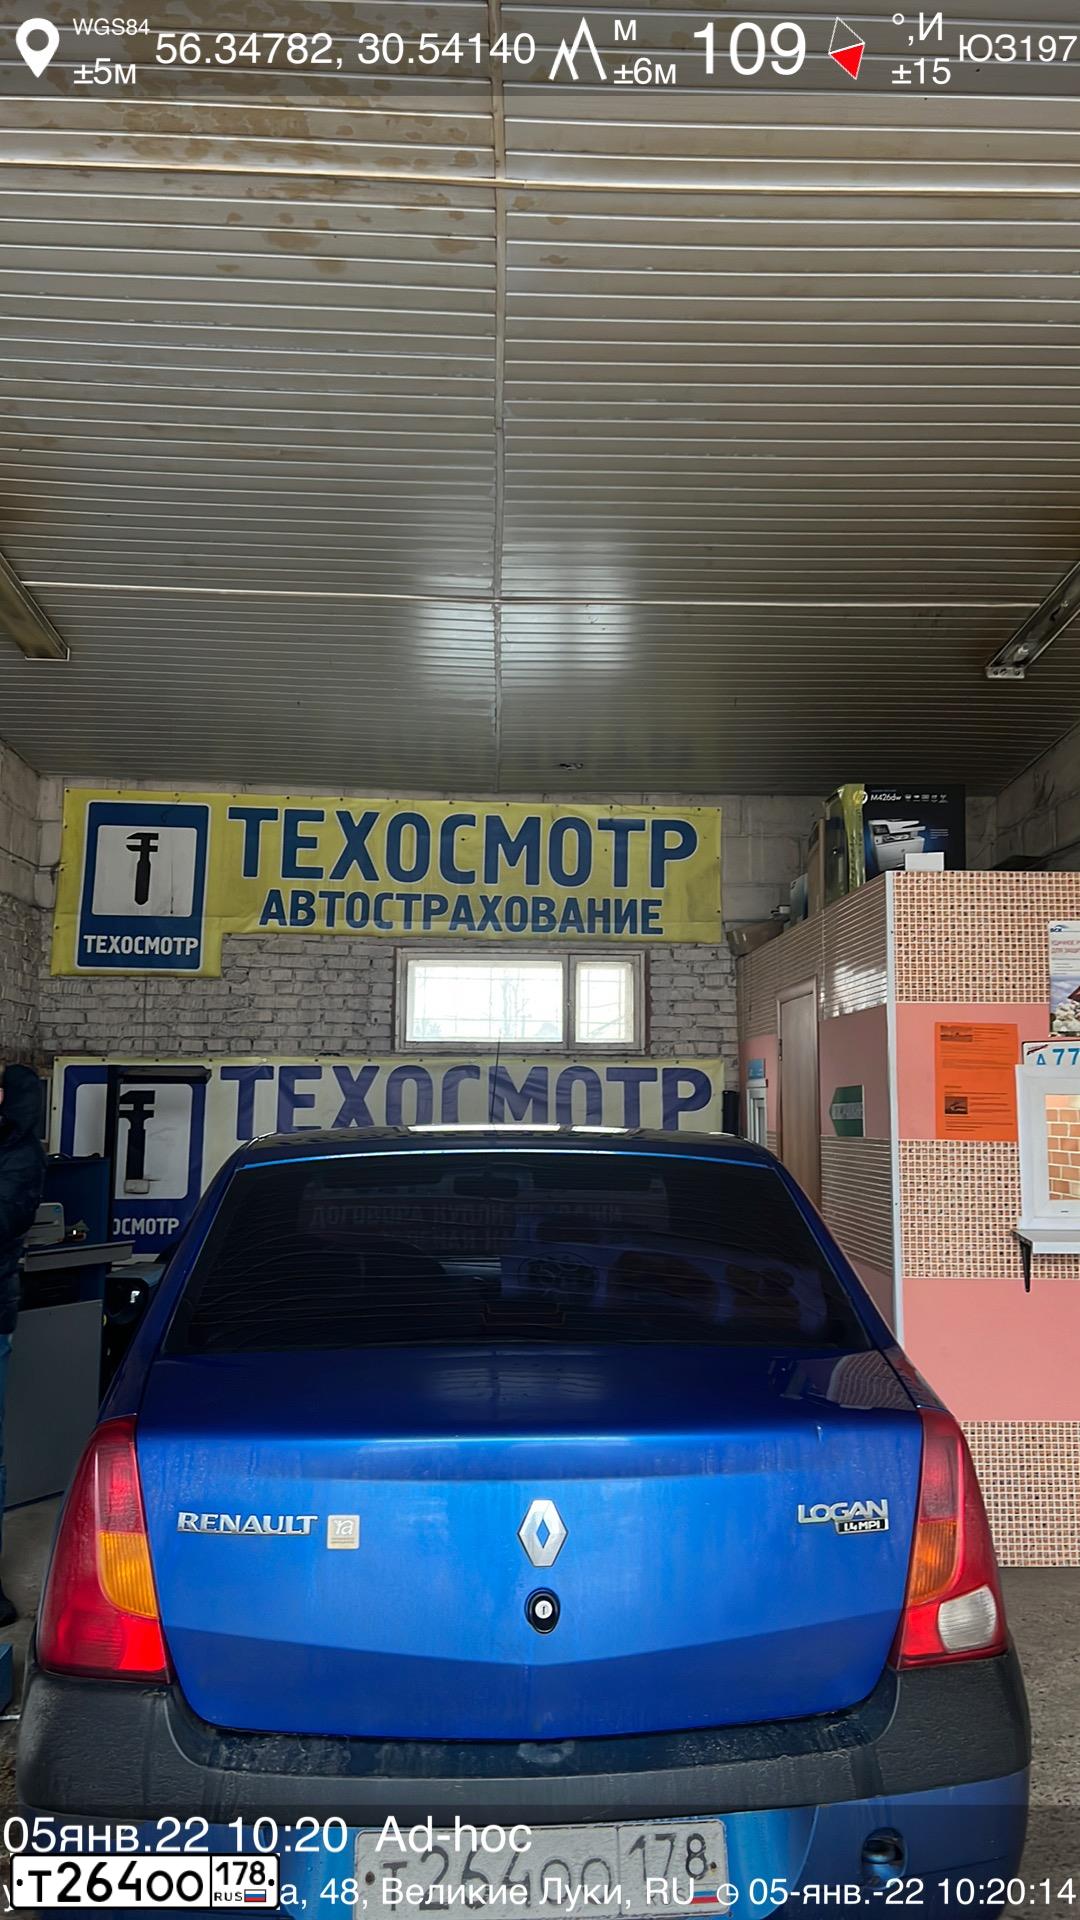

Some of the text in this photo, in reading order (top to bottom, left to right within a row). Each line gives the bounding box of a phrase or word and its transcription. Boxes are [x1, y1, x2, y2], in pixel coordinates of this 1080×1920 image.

[227, 805, 699, 890] ТЕХОСМОТР
[258, 888, 665, 937] АВТОСТРАХОВАНИЕ
[83, 933, 200, 957] ТЕХОСМОТР
[219, 1065, 713, 1141] ТЕХОСМОТР
[112, 1217, 181, 1236] ОСМОТР
[177, 1511, 319, 1536] RENAULT
[797, 1498, 888, 1524] LOGAN
[629, 1832, 708, 1881] 178
